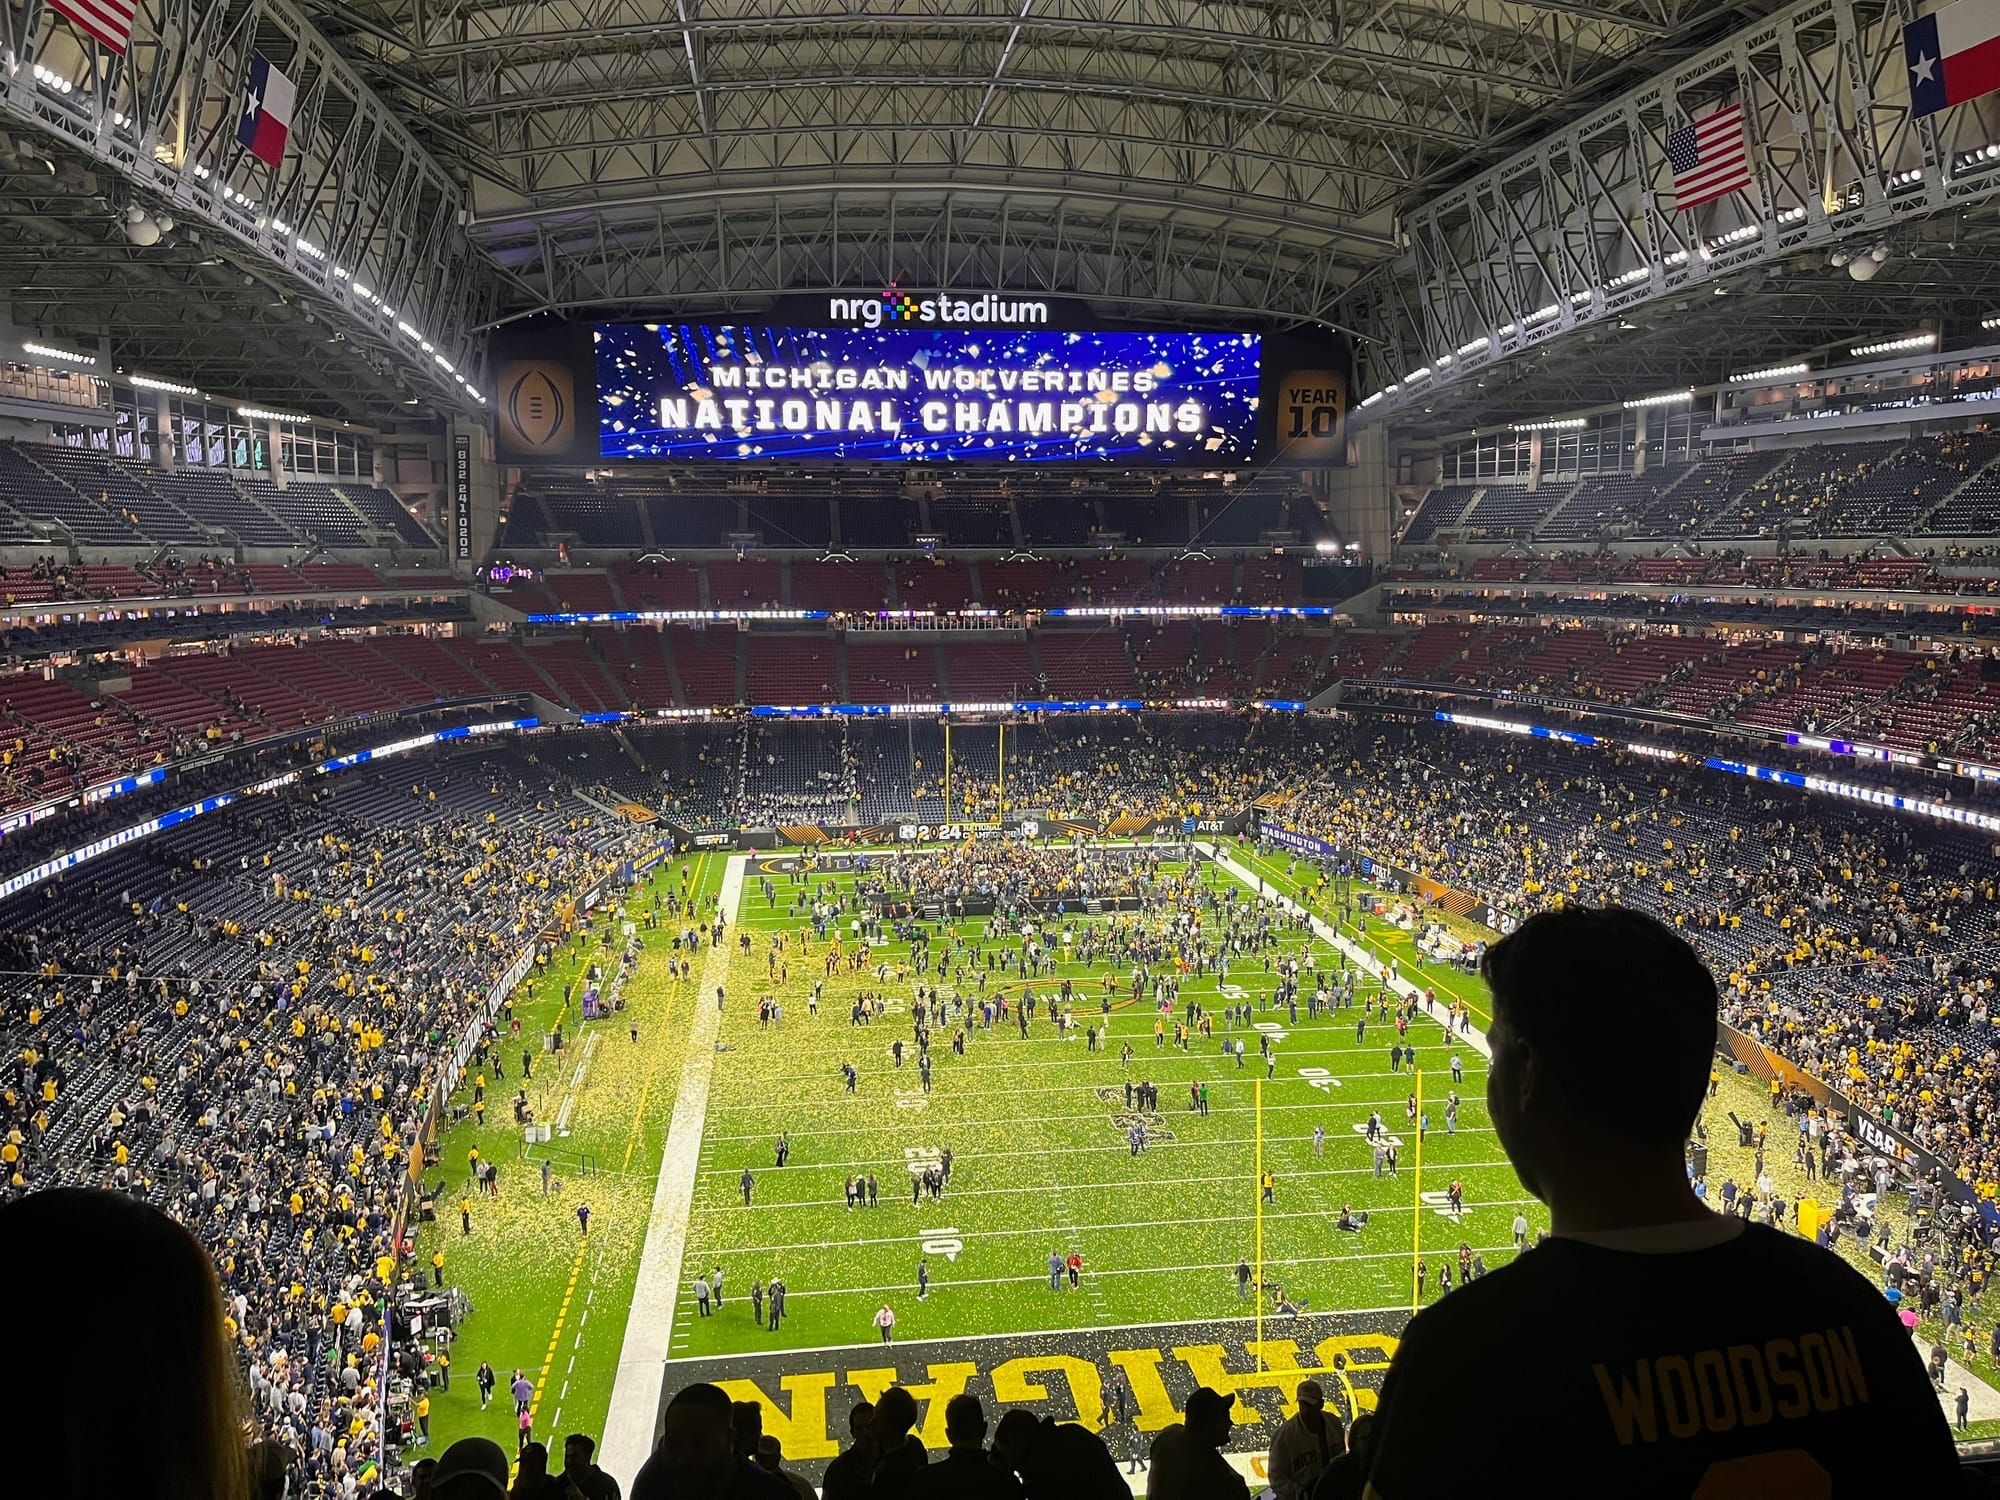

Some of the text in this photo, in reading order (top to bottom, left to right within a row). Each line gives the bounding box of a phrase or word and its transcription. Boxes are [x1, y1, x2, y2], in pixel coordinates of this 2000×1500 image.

[830, 294, 1047, 327] nrg stadium
[711, 367, 1152, 391] MICHIGAN WOLVERINES
[1288, 389, 1337, 403] YEAR
[661, 399, 1201, 432] NATIONAL CHAMPIONS
[1288, 406, 1337, 438] 10
[890, 704, 1013, 713] NATIONAL CHAMPIONS
[1497, 694, 1548, 705] WASHINGTON
[320, 721, 357, 734] MICHIGAN
[1805, 777, 1894, 805] MICHIGAN
[1197, 820, 1225, 831] AT&T
[76, 819, 159, 863] WOLVERINES
[1261, 826, 1321, 852] WASHINGTON
[633, 845, 665, 870] MICHIGAN
[1371, 863, 1388, 879] AT&T
[1858, 1115, 1895, 1157] YEAR
[919, 1227, 963, 1254] 10
[1591, 1325, 1869, 1447] WOODSON
